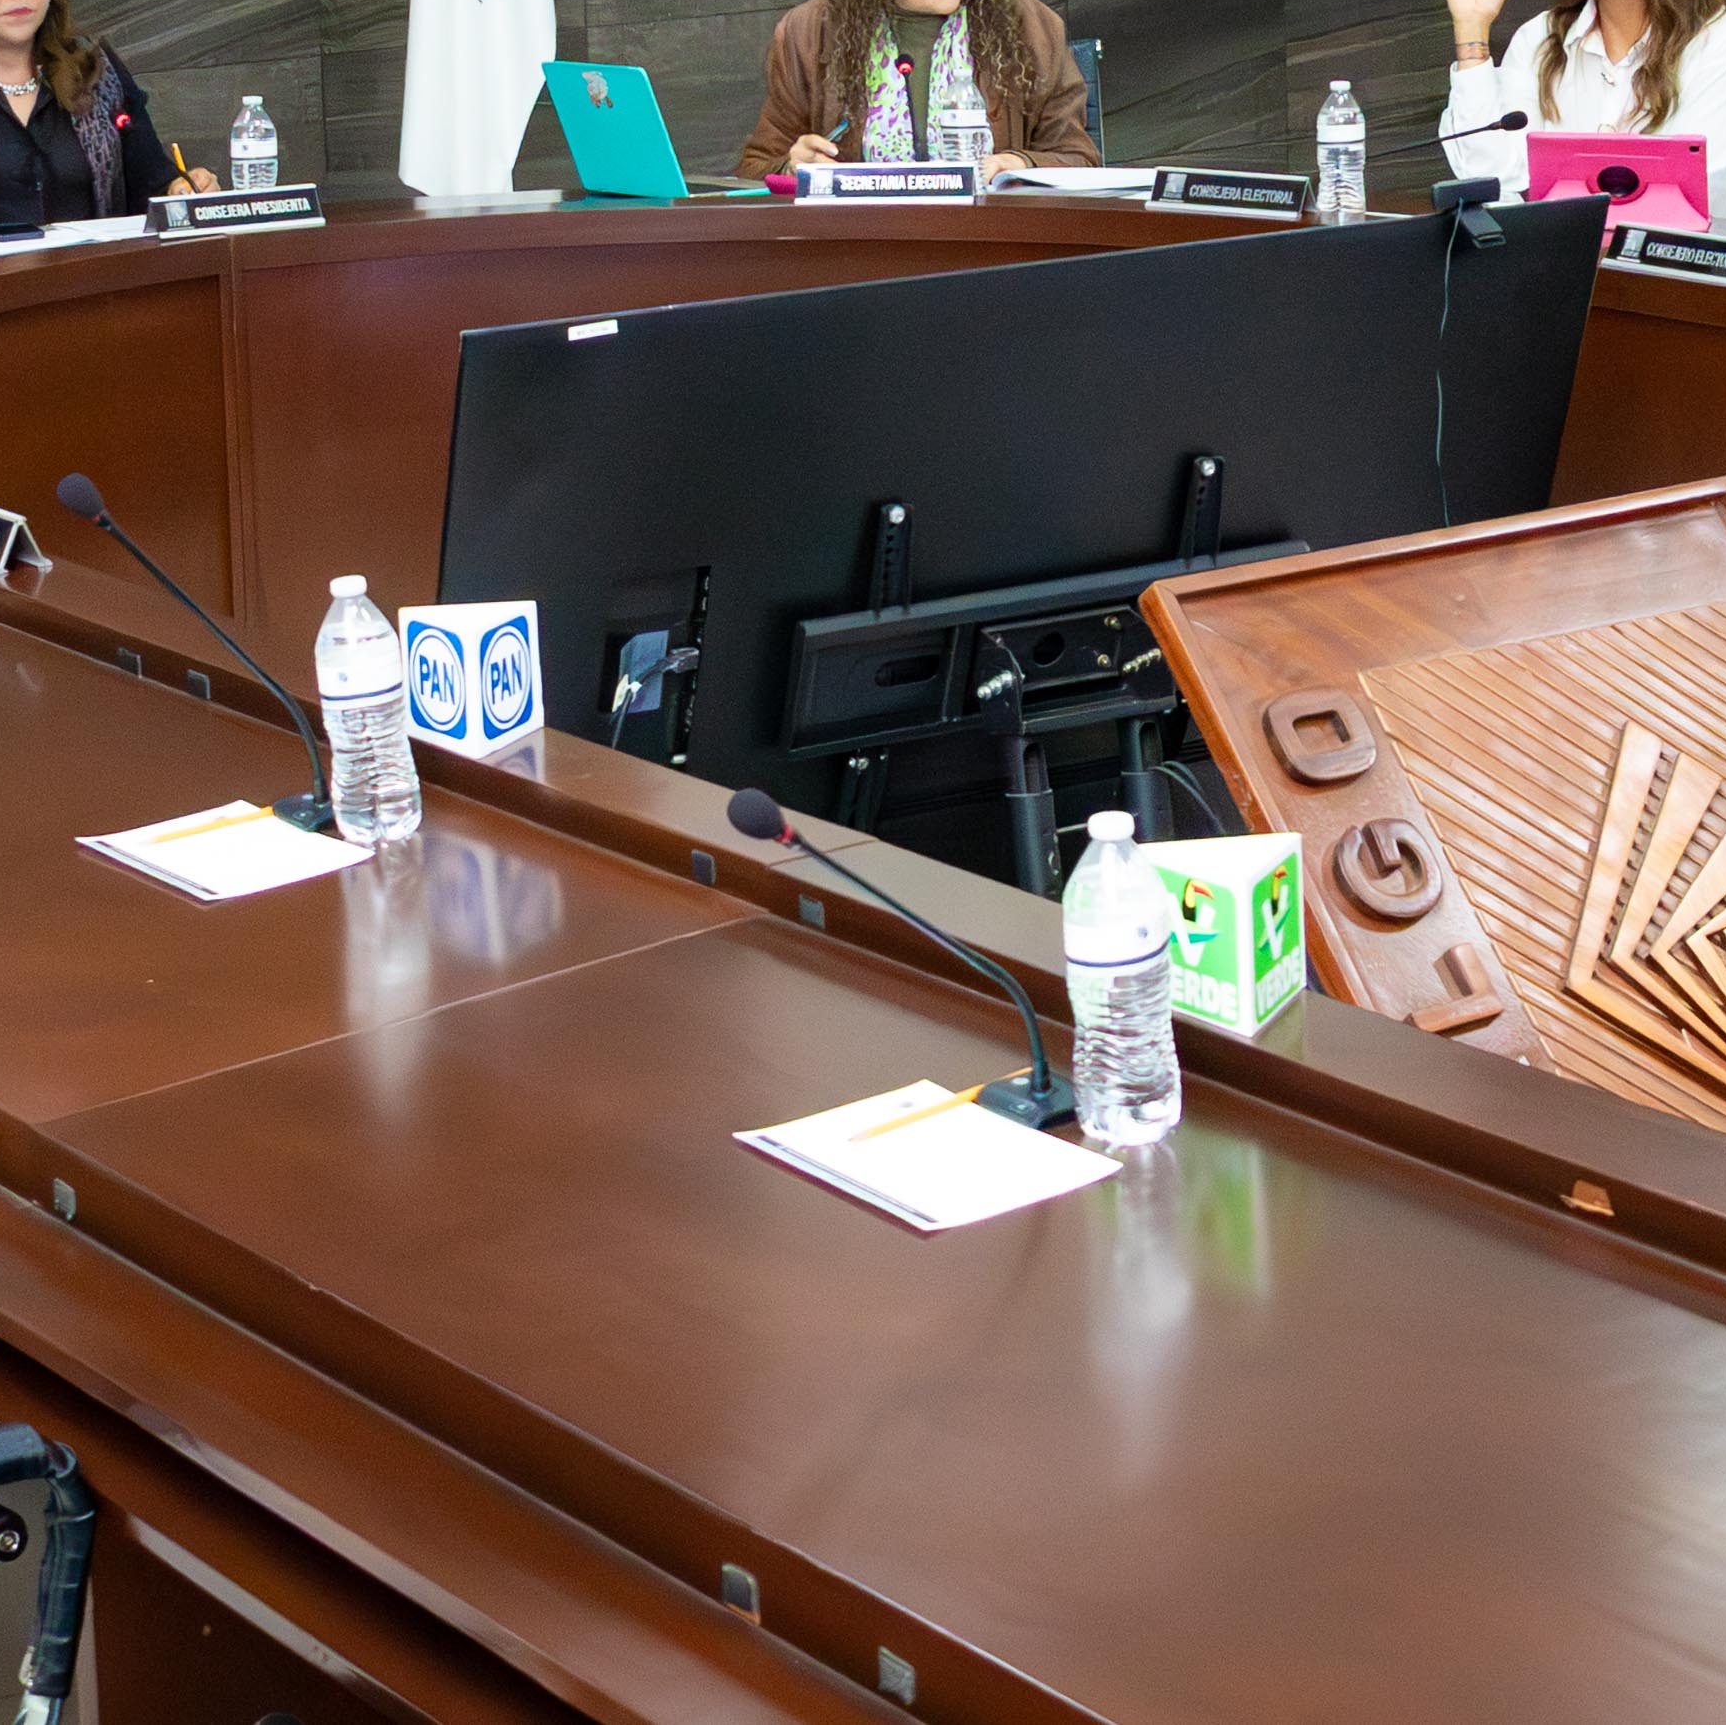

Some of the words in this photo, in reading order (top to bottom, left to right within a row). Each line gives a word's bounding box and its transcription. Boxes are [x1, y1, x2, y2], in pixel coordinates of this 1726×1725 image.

[839, 175, 907, 191] SECRETARIA
[907, 174, 964, 190] EJECUTIVA
[1189, 184, 1242, 201] CONSEJERA
[1242, 188, 1295, 205] ELECTORAL
[194, 202, 251, 221] CONSEJERA
[251, 197, 312, 216] PRESIDENTA
[419, 655, 457, 706] PAN
[490, 650, 522, 706] PAN
[1170, 963, 1238, 1024] ERDE
[1255, 944, 1300, 1018] VERDE
